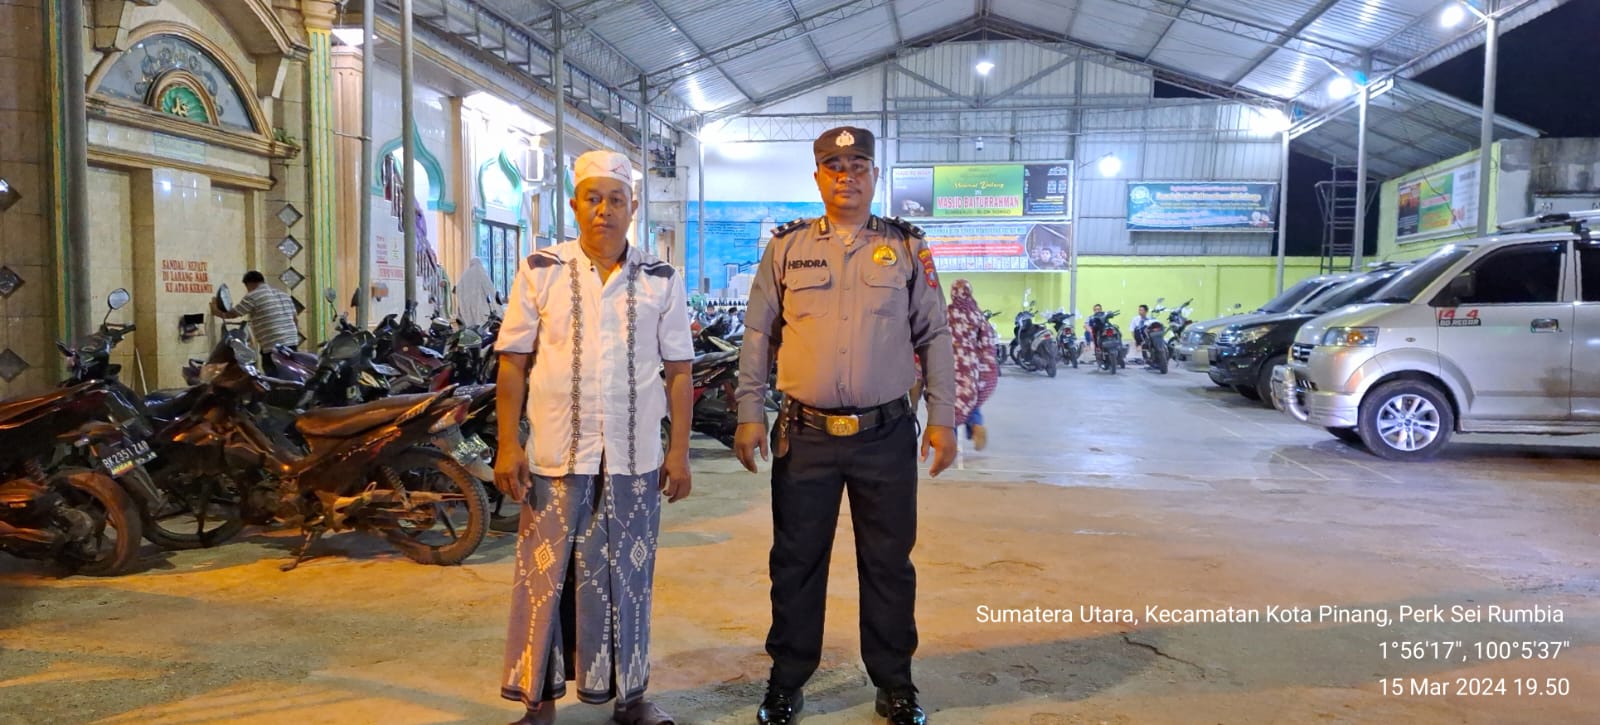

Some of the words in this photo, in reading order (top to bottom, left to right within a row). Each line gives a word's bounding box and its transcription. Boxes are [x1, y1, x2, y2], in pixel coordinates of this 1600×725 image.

[937, 196, 962, 209] MASJID
[964, 195, 1019, 208] BAITURRAHMAN
[788, 259, 828, 269] HENDRA
[171, 271, 193, 281] LARANG
